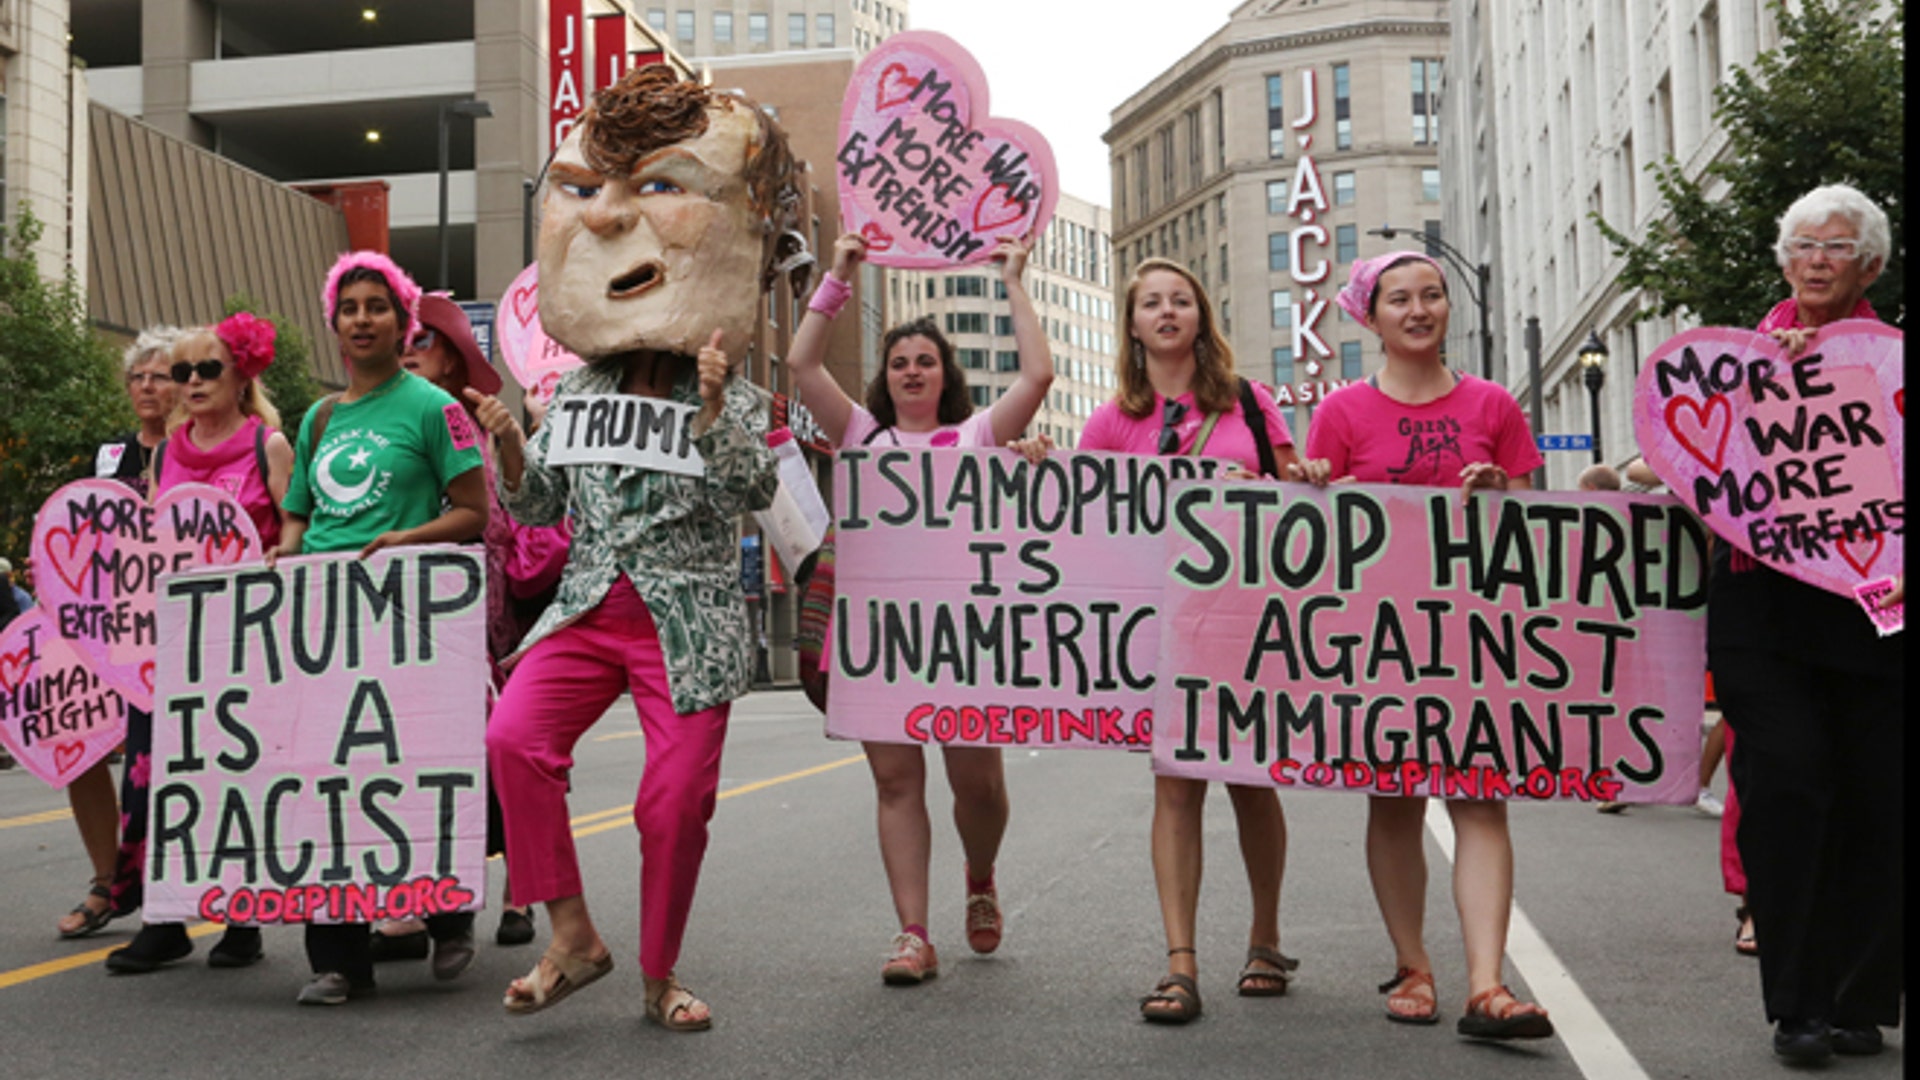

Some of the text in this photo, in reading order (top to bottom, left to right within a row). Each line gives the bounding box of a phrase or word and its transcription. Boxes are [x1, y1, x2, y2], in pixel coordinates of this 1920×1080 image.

[875, 117, 974, 210] MORE
[910, 69, 1041, 216] MORE WAR
[837, 131, 984, 260] EXTREMISM
[1656, 346, 1834, 404] MORE
[1745, 402, 1885, 456] WAR
[67, 493, 157, 543] MORE
[840, 451, 1238, 535] ISLAMOPHO
[1694, 454, 1853, 518] MORE
[968, 540, 1061, 596] IS
[1174, 489, 1708, 620] STOP HATRED
[23, 624, 41, 667] I
[167, 553, 482, 684] TRUMP
[1244, 596, 1636, 693] AGAINST
[0, 665, 98, 720] HUMA
[167, 680, 400, 773] IS A
[1174, 677, 1665, 784] IMMIGRANTS
[1269, 758, 1625, 801] CODEPINK.ORG
[151, 773, 474, 887] RACIST
